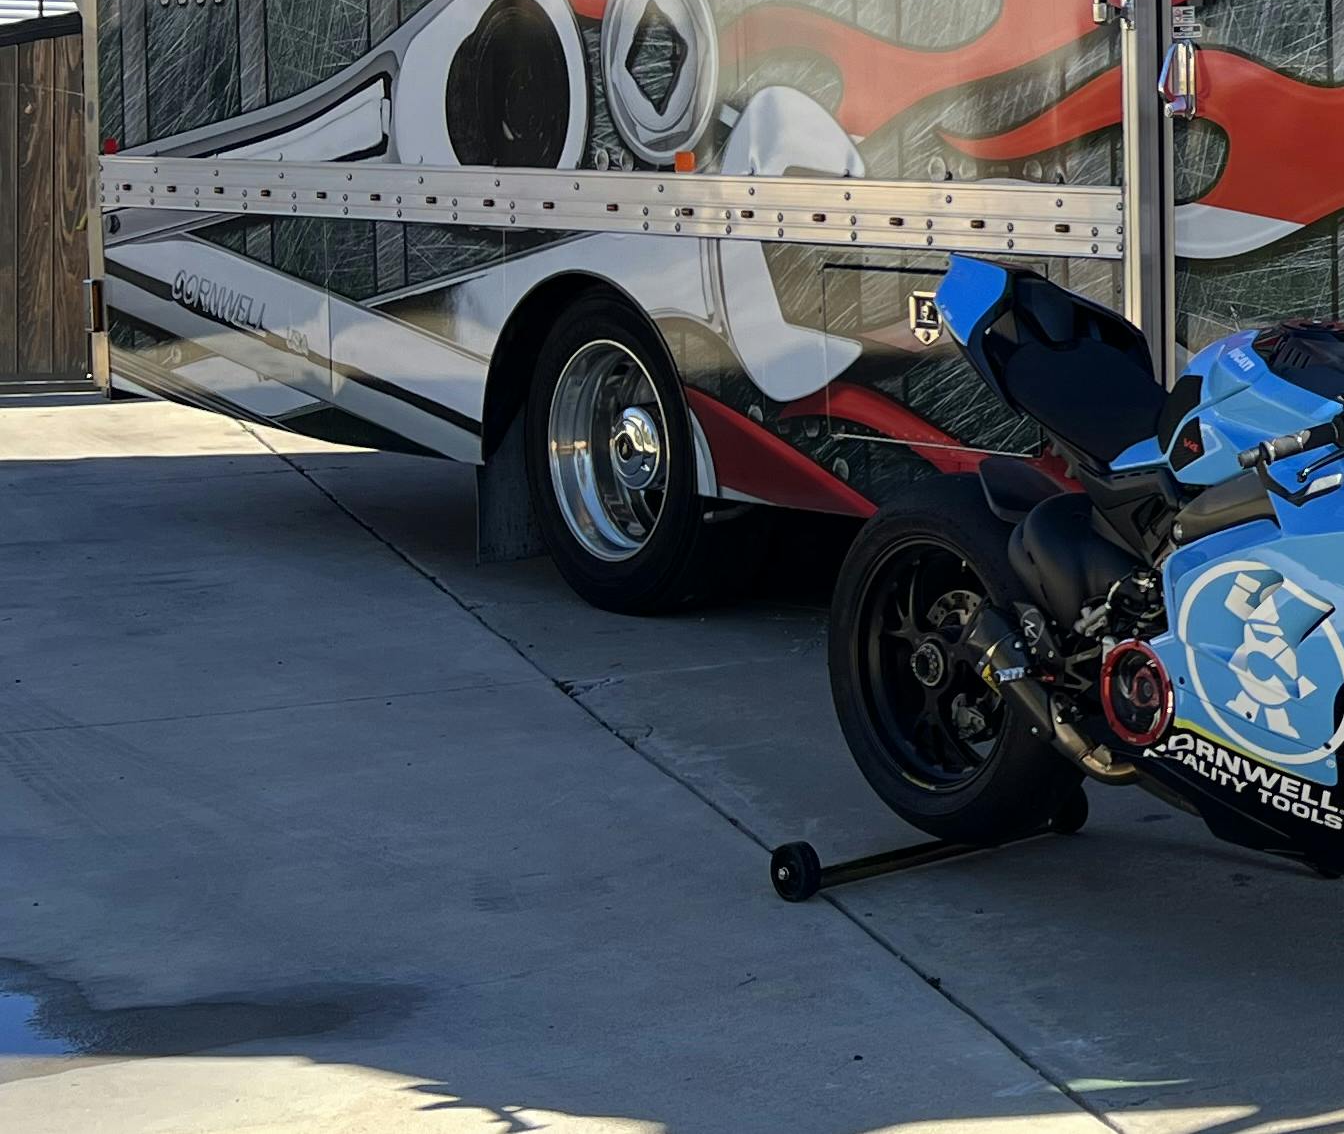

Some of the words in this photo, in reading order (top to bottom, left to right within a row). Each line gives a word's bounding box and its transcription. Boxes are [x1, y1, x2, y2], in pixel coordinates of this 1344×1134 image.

[171, 269, 268, 338] CORNWELL
[1154, 733, 1340, 813] ORNWELL
[1257, 787, 1344, 831] TOOLS
